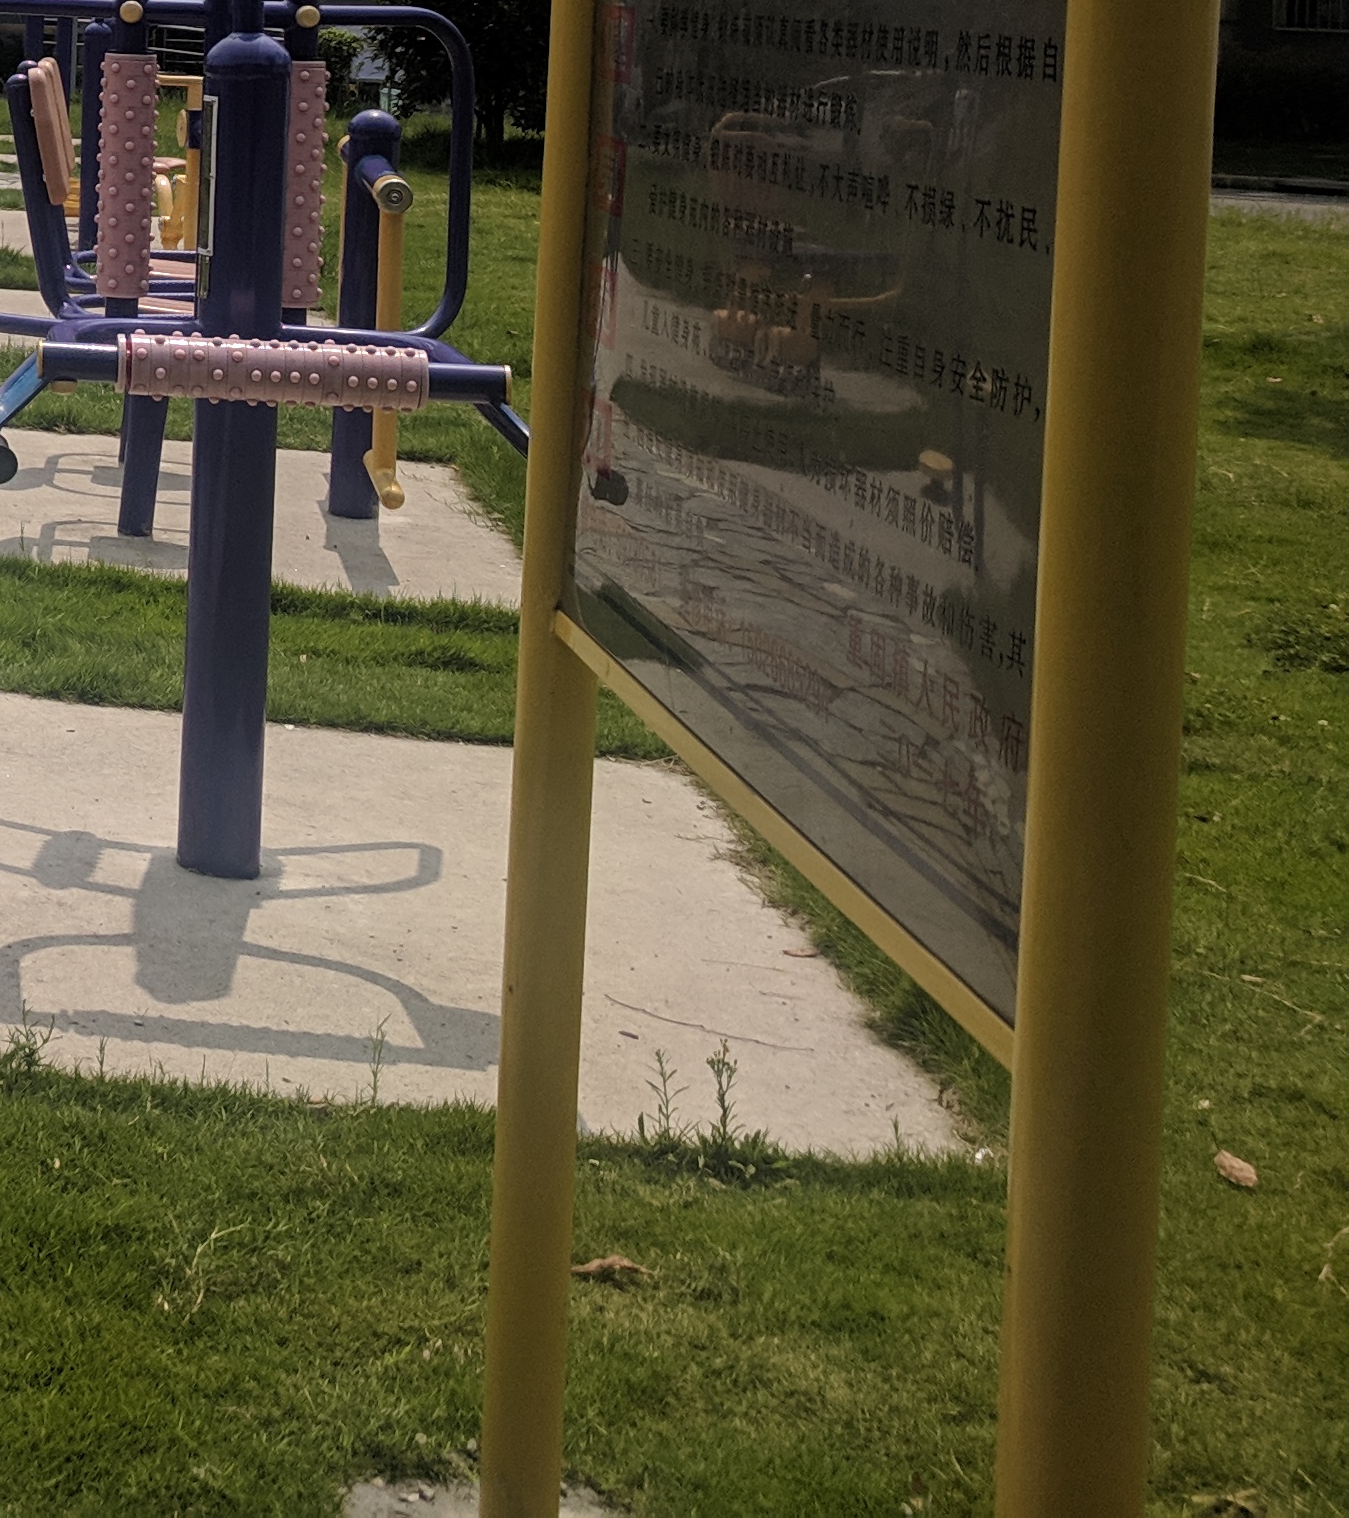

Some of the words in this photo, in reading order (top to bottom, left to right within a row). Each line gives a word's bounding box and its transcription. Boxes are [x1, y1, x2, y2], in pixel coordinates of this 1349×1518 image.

[846, 612, 1023, 775] 重固镇人民政府
